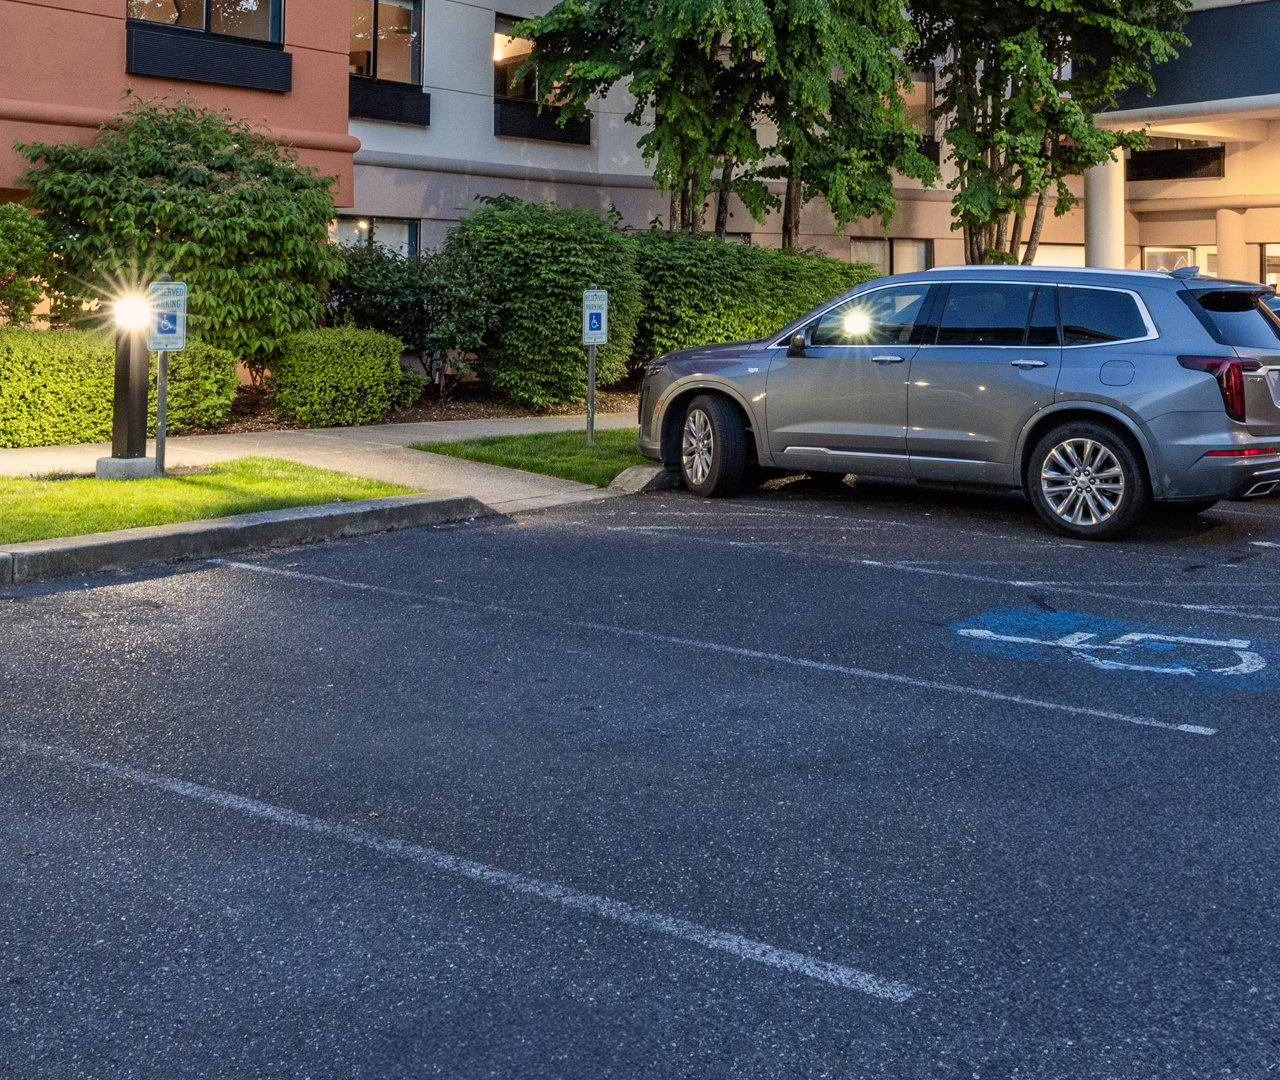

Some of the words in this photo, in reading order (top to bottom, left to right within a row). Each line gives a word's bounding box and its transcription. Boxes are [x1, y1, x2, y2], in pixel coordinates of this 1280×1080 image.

[584, 294, 607, 302] RESERVED
[152, 299, 181, 309] ARKING
[586, 303, 604, 311] PARKING
